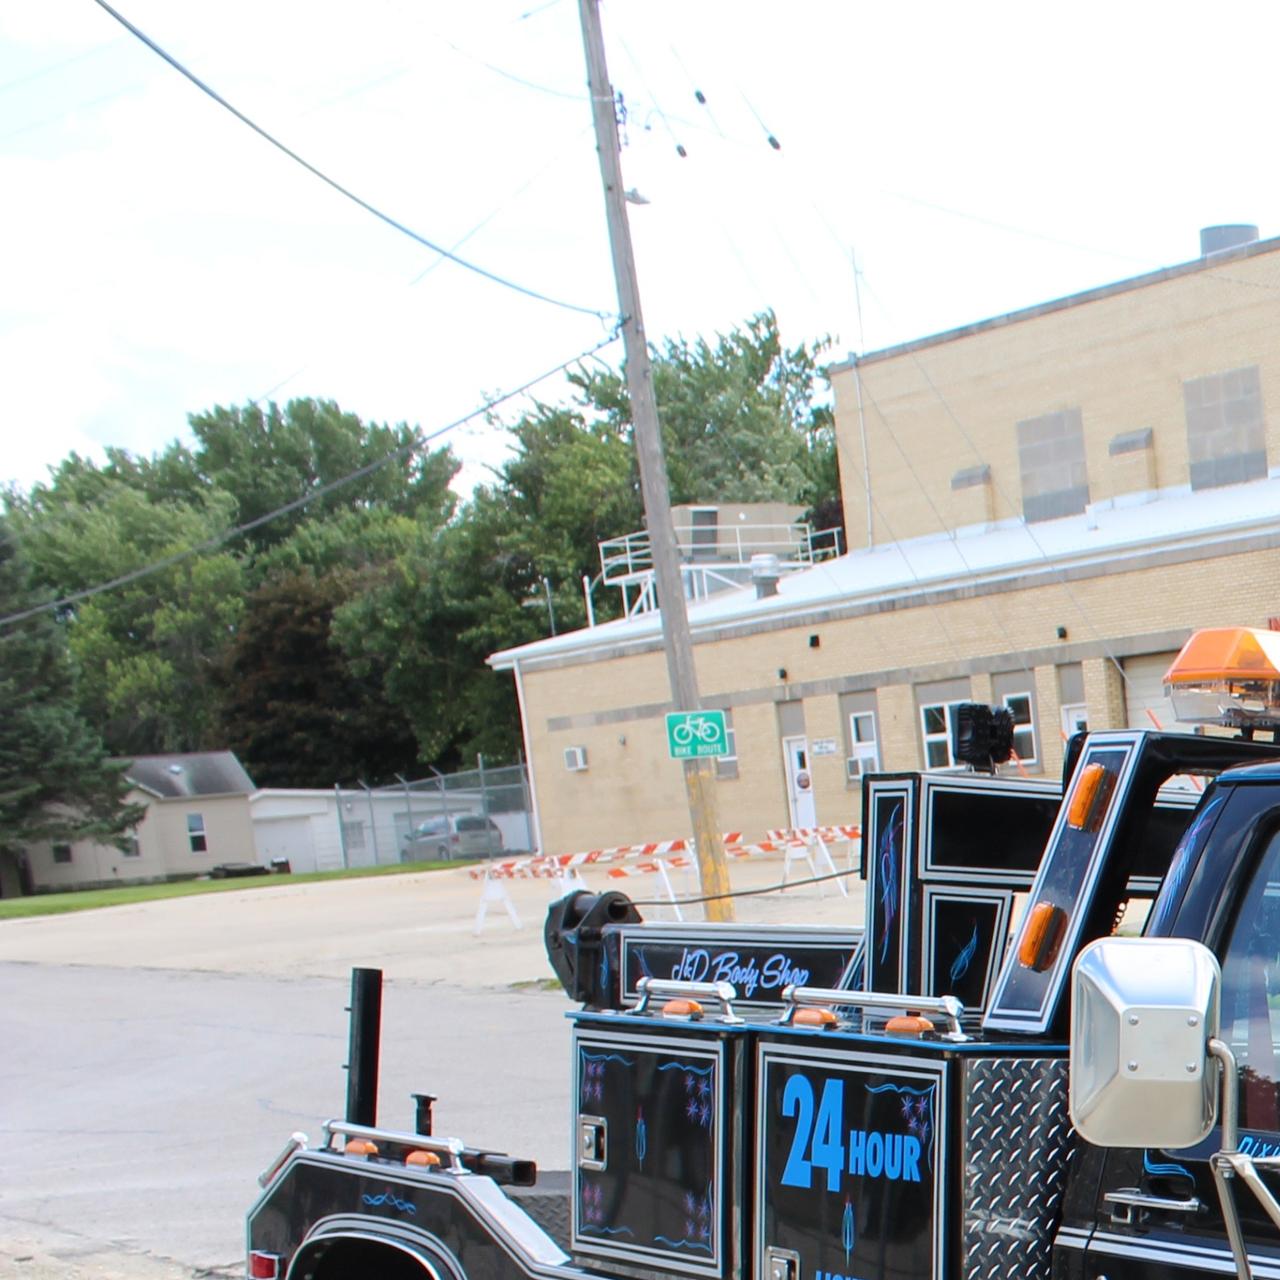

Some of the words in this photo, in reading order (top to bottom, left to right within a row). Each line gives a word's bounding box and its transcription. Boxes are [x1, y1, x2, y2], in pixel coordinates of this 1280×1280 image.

[675, 745, 691, 756] BIKE
[712, 952, 759, 998] Body
[761, 953, 809, 988] Shop
[780, 1073, 844, 1192] 24
[849, 1130, 921, 1183] HOUR
